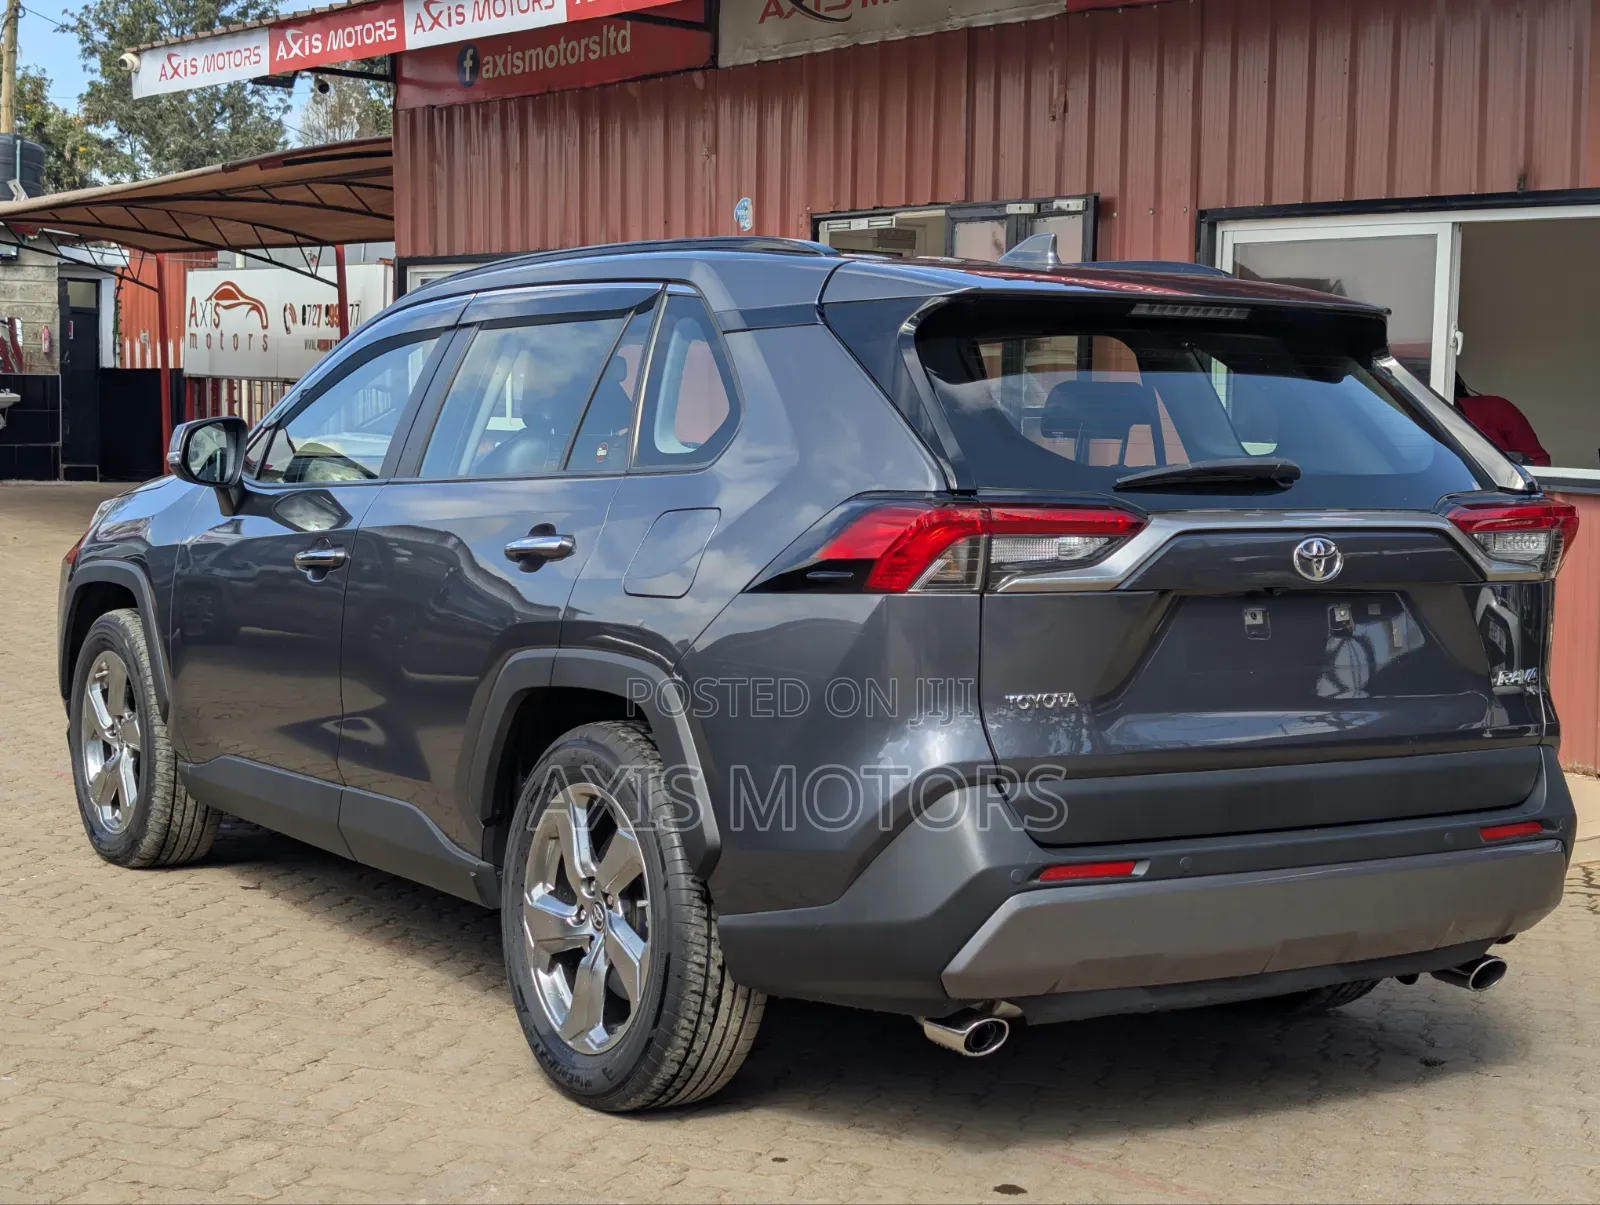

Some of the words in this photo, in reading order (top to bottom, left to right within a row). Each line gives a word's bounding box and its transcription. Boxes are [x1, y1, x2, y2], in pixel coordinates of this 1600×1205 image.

[327, 18, 398, 52] MOTORS
[202, 46, 262, 74] MOTORS
[481, 21, 631, 79] axismotorsltd
[189, 330, 269, 352] motors
[1496, 667, 1539, 686] RAV4
[1004, 692, 1079, 709] TOYOTA
